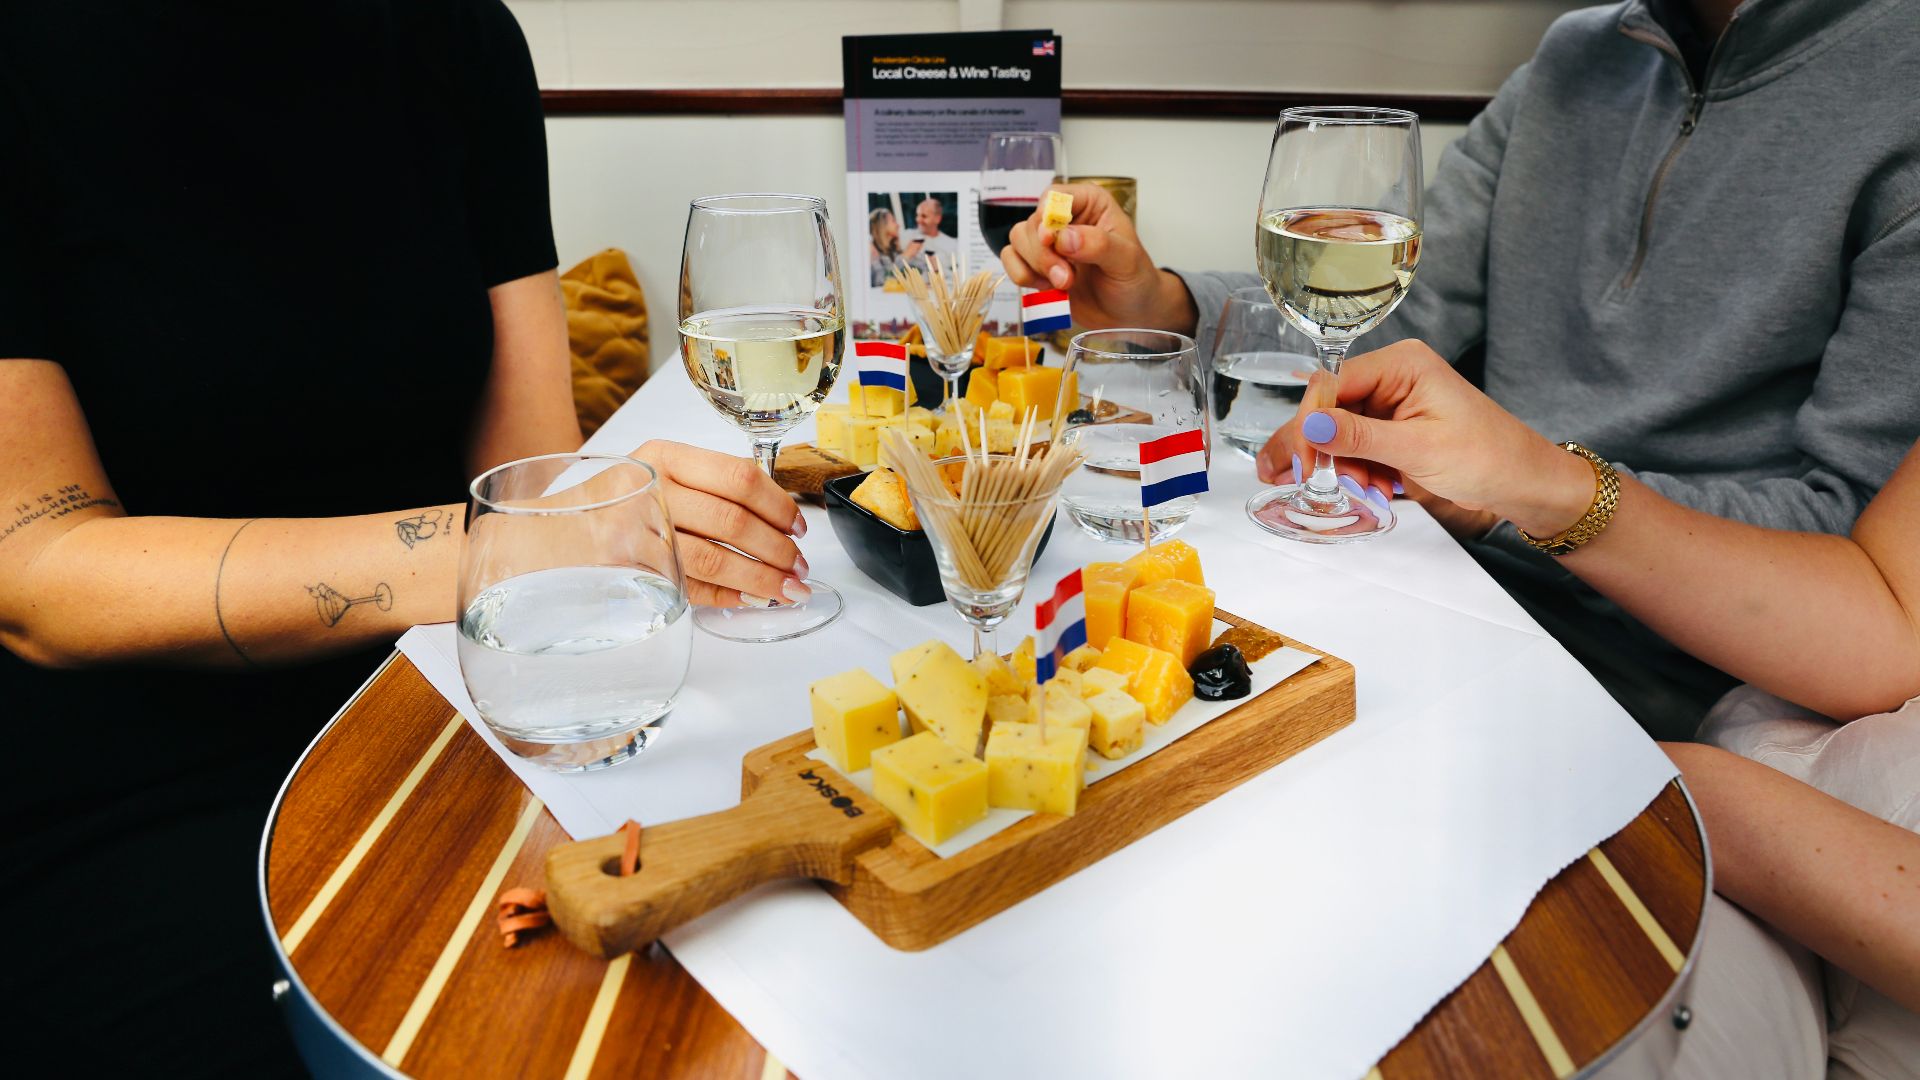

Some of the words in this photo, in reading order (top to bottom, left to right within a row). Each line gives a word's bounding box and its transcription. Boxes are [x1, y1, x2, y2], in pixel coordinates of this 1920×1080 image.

[872, 67, 902, 79] Local
[903, 66, 947, 79] Cheese
[948, 66, 958, 79] &
[959, 66, 989, 79] Wine
[990, 66, 1031, 81] Tasting
[797, 769, 864, 818] BOSKA
